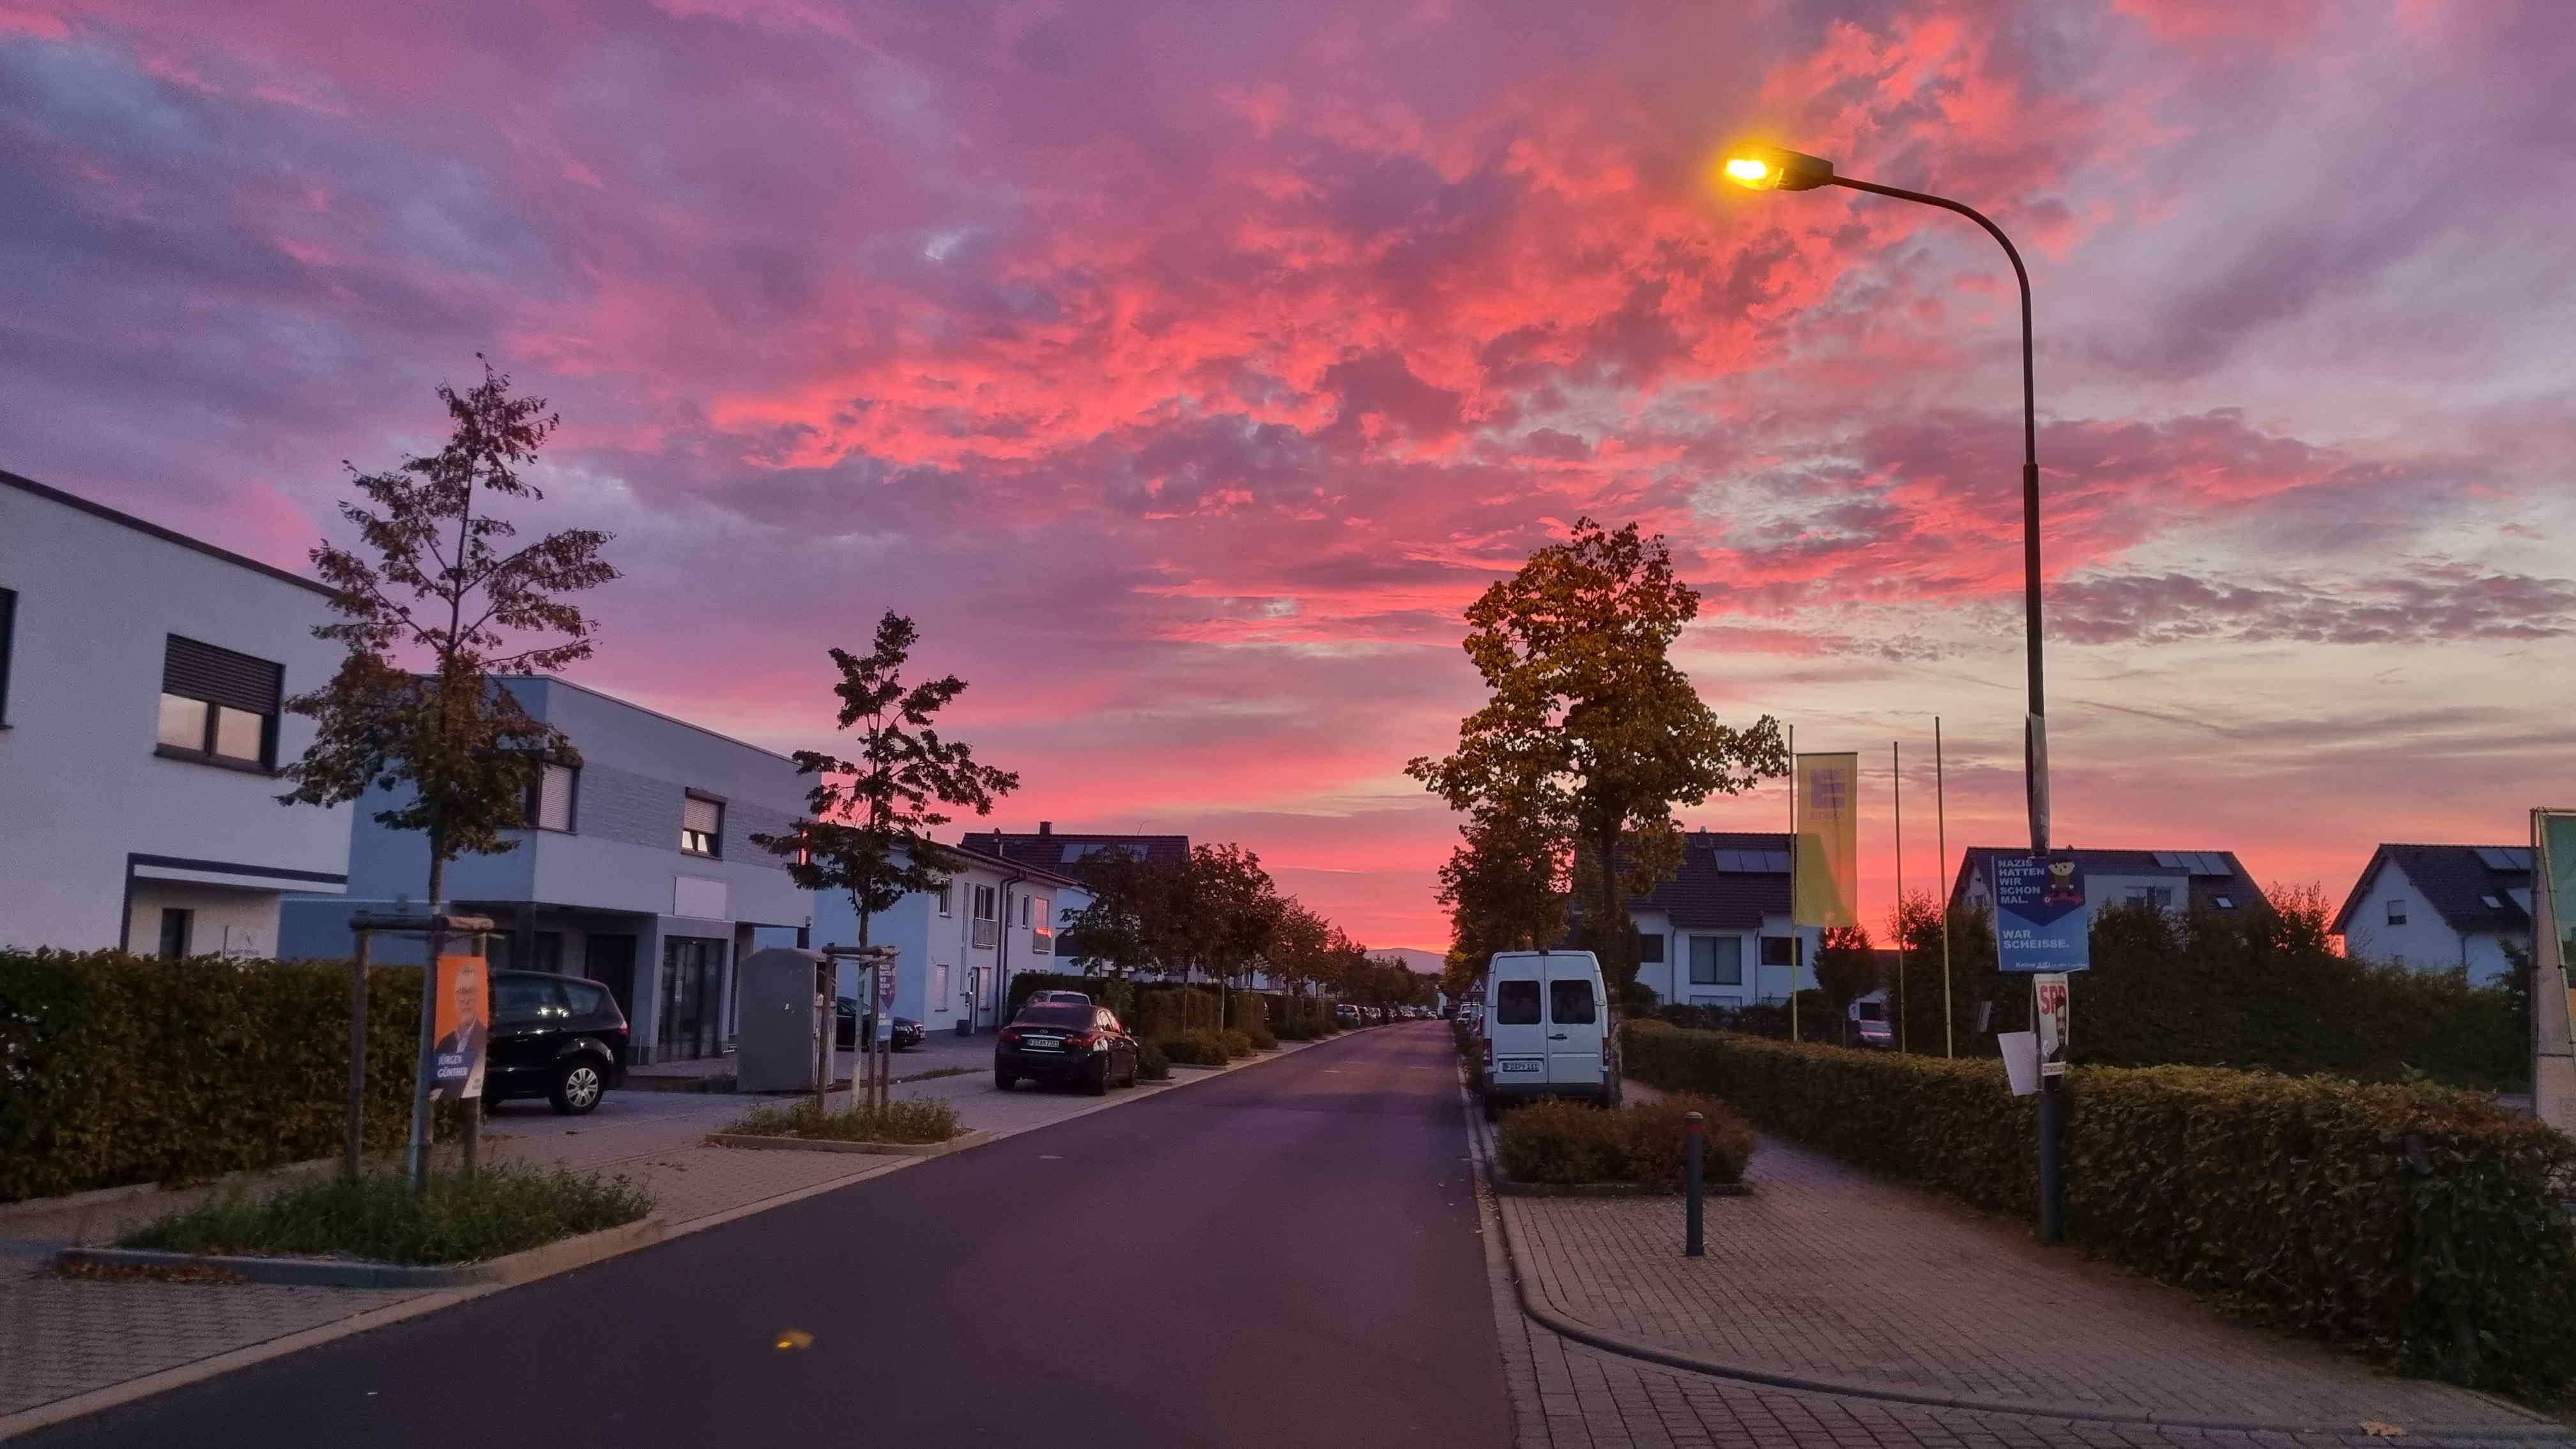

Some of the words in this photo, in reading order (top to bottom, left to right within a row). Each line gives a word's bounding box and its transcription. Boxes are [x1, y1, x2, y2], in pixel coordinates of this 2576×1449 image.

[1998, 859, 2033, 868] NAZIS
[1998, 868, 2044, 877] HATTEN
[1998, 877, 2021, 885] WIR
[2000, 885, 2041, 895] SCHON
[2000, 896, 2029, 904] MAL.
[2002, 930, 2032, 939] WAR
[2003, 939, 2071, 949] SCHEISSE.
